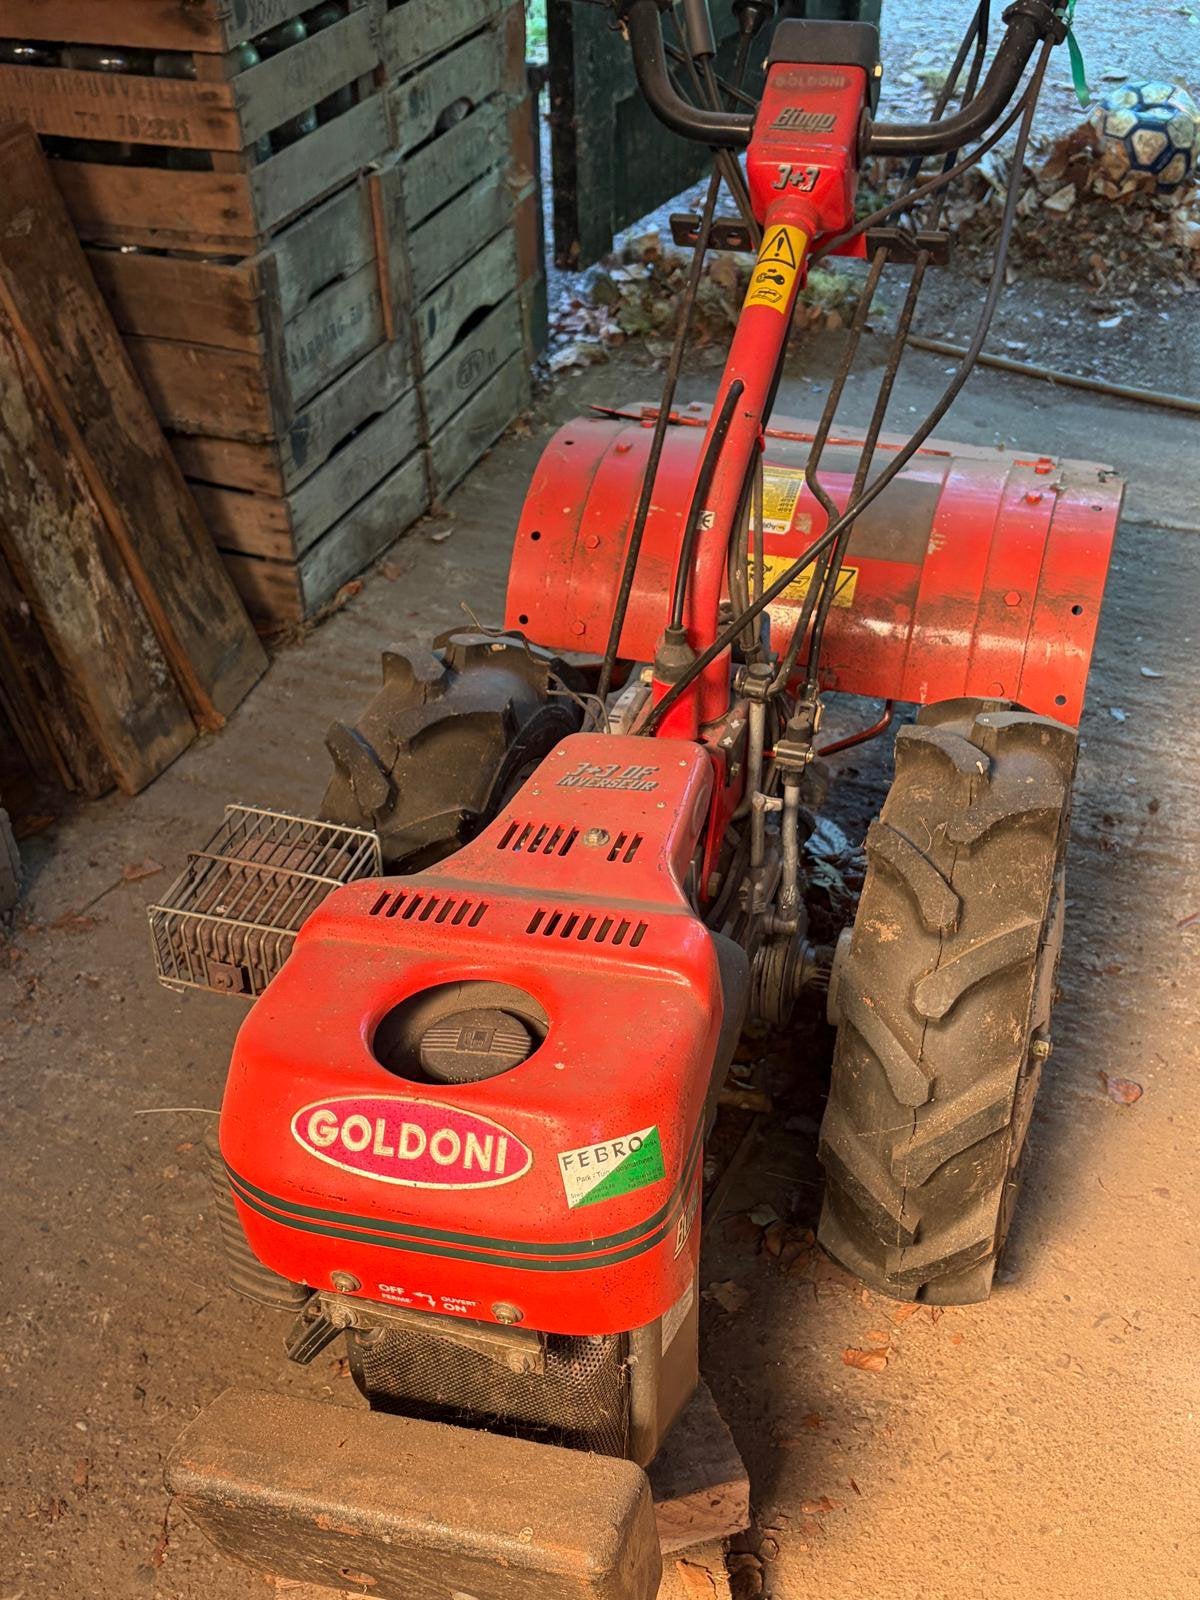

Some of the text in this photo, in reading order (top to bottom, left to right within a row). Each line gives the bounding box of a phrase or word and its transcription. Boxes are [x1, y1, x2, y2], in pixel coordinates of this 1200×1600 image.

[773, 106, 837, 132] Bingo
[565, 762, 621, 778] 3+3
[556, 775, 660, 792] INVERSEUR
[307, 1108, 508, 1174] GOLDONI
[561, 1136, 644, 1171] FEBRO
[378, 1283, 405, 1295] OFF
[440, 1296, 477, 1307] OUVERT
[442, 1303, 468, 1313] ON
